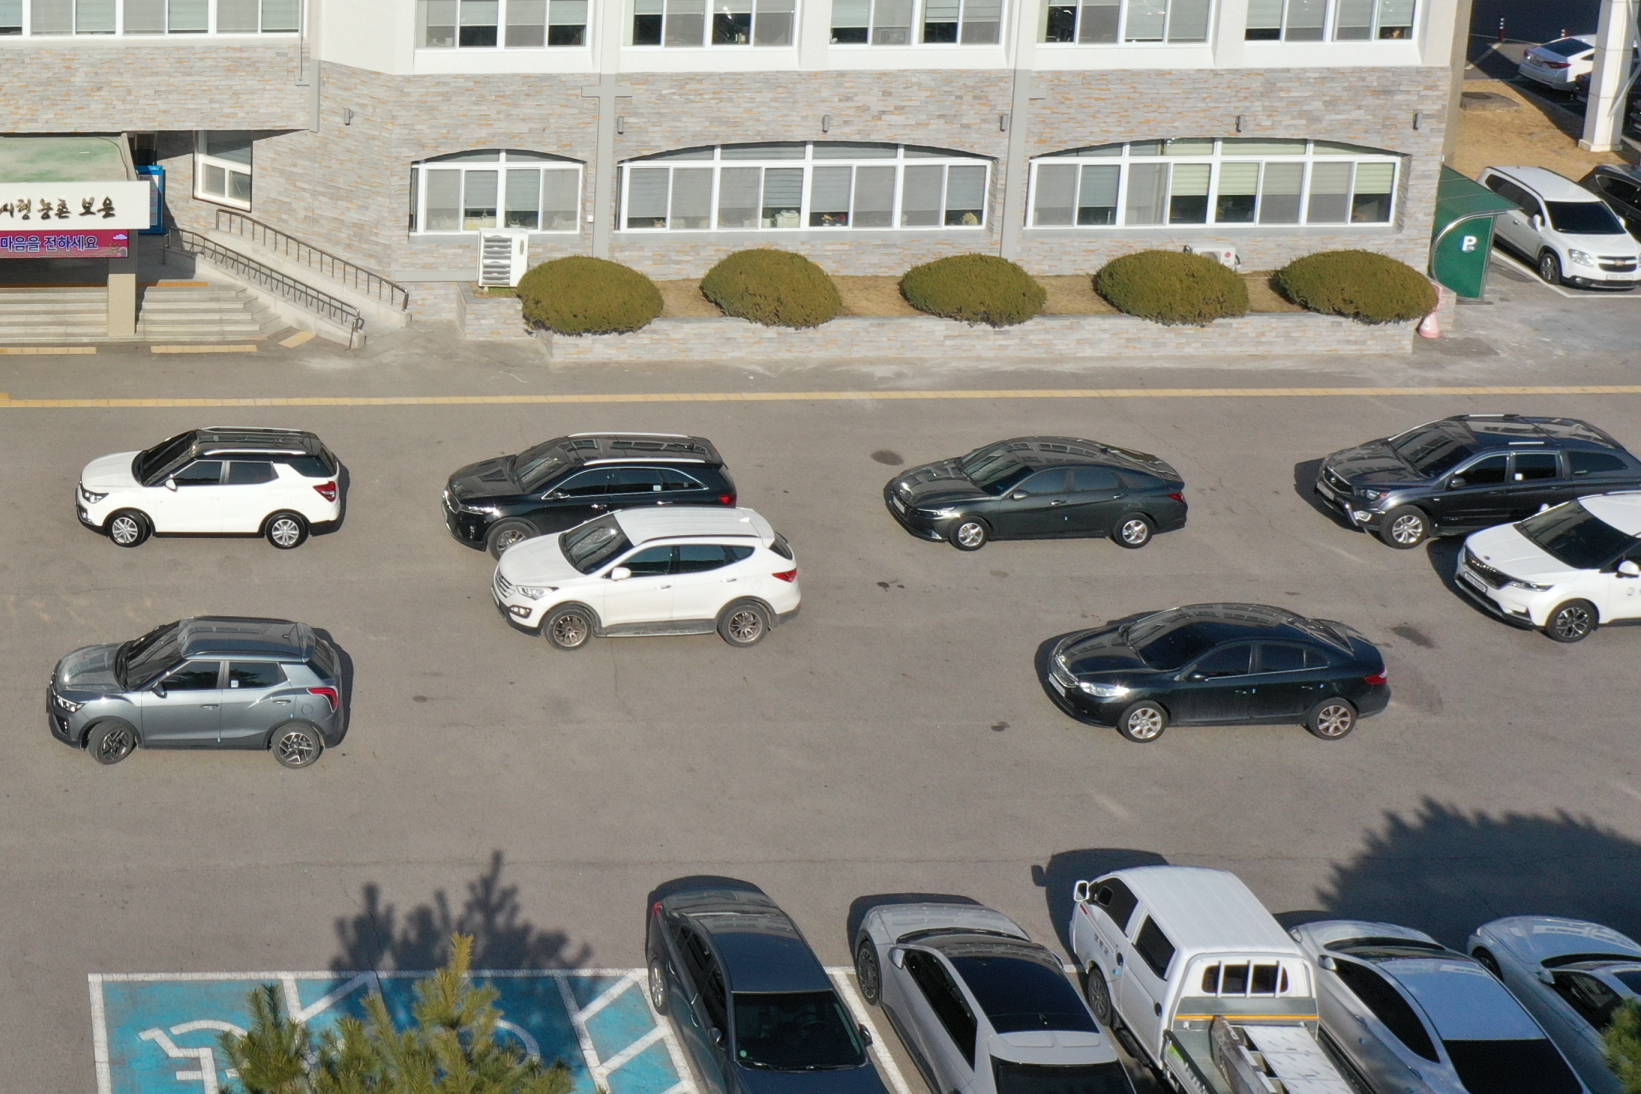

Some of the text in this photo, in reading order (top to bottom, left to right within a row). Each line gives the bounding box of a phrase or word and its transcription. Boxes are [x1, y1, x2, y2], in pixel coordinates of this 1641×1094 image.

[78, 196, 116, 219] 보은
[0, 235, 42, 253] 마음을
[43, 234, 99, 252] 전하세요
[1461, 235, 1477, 251] P
